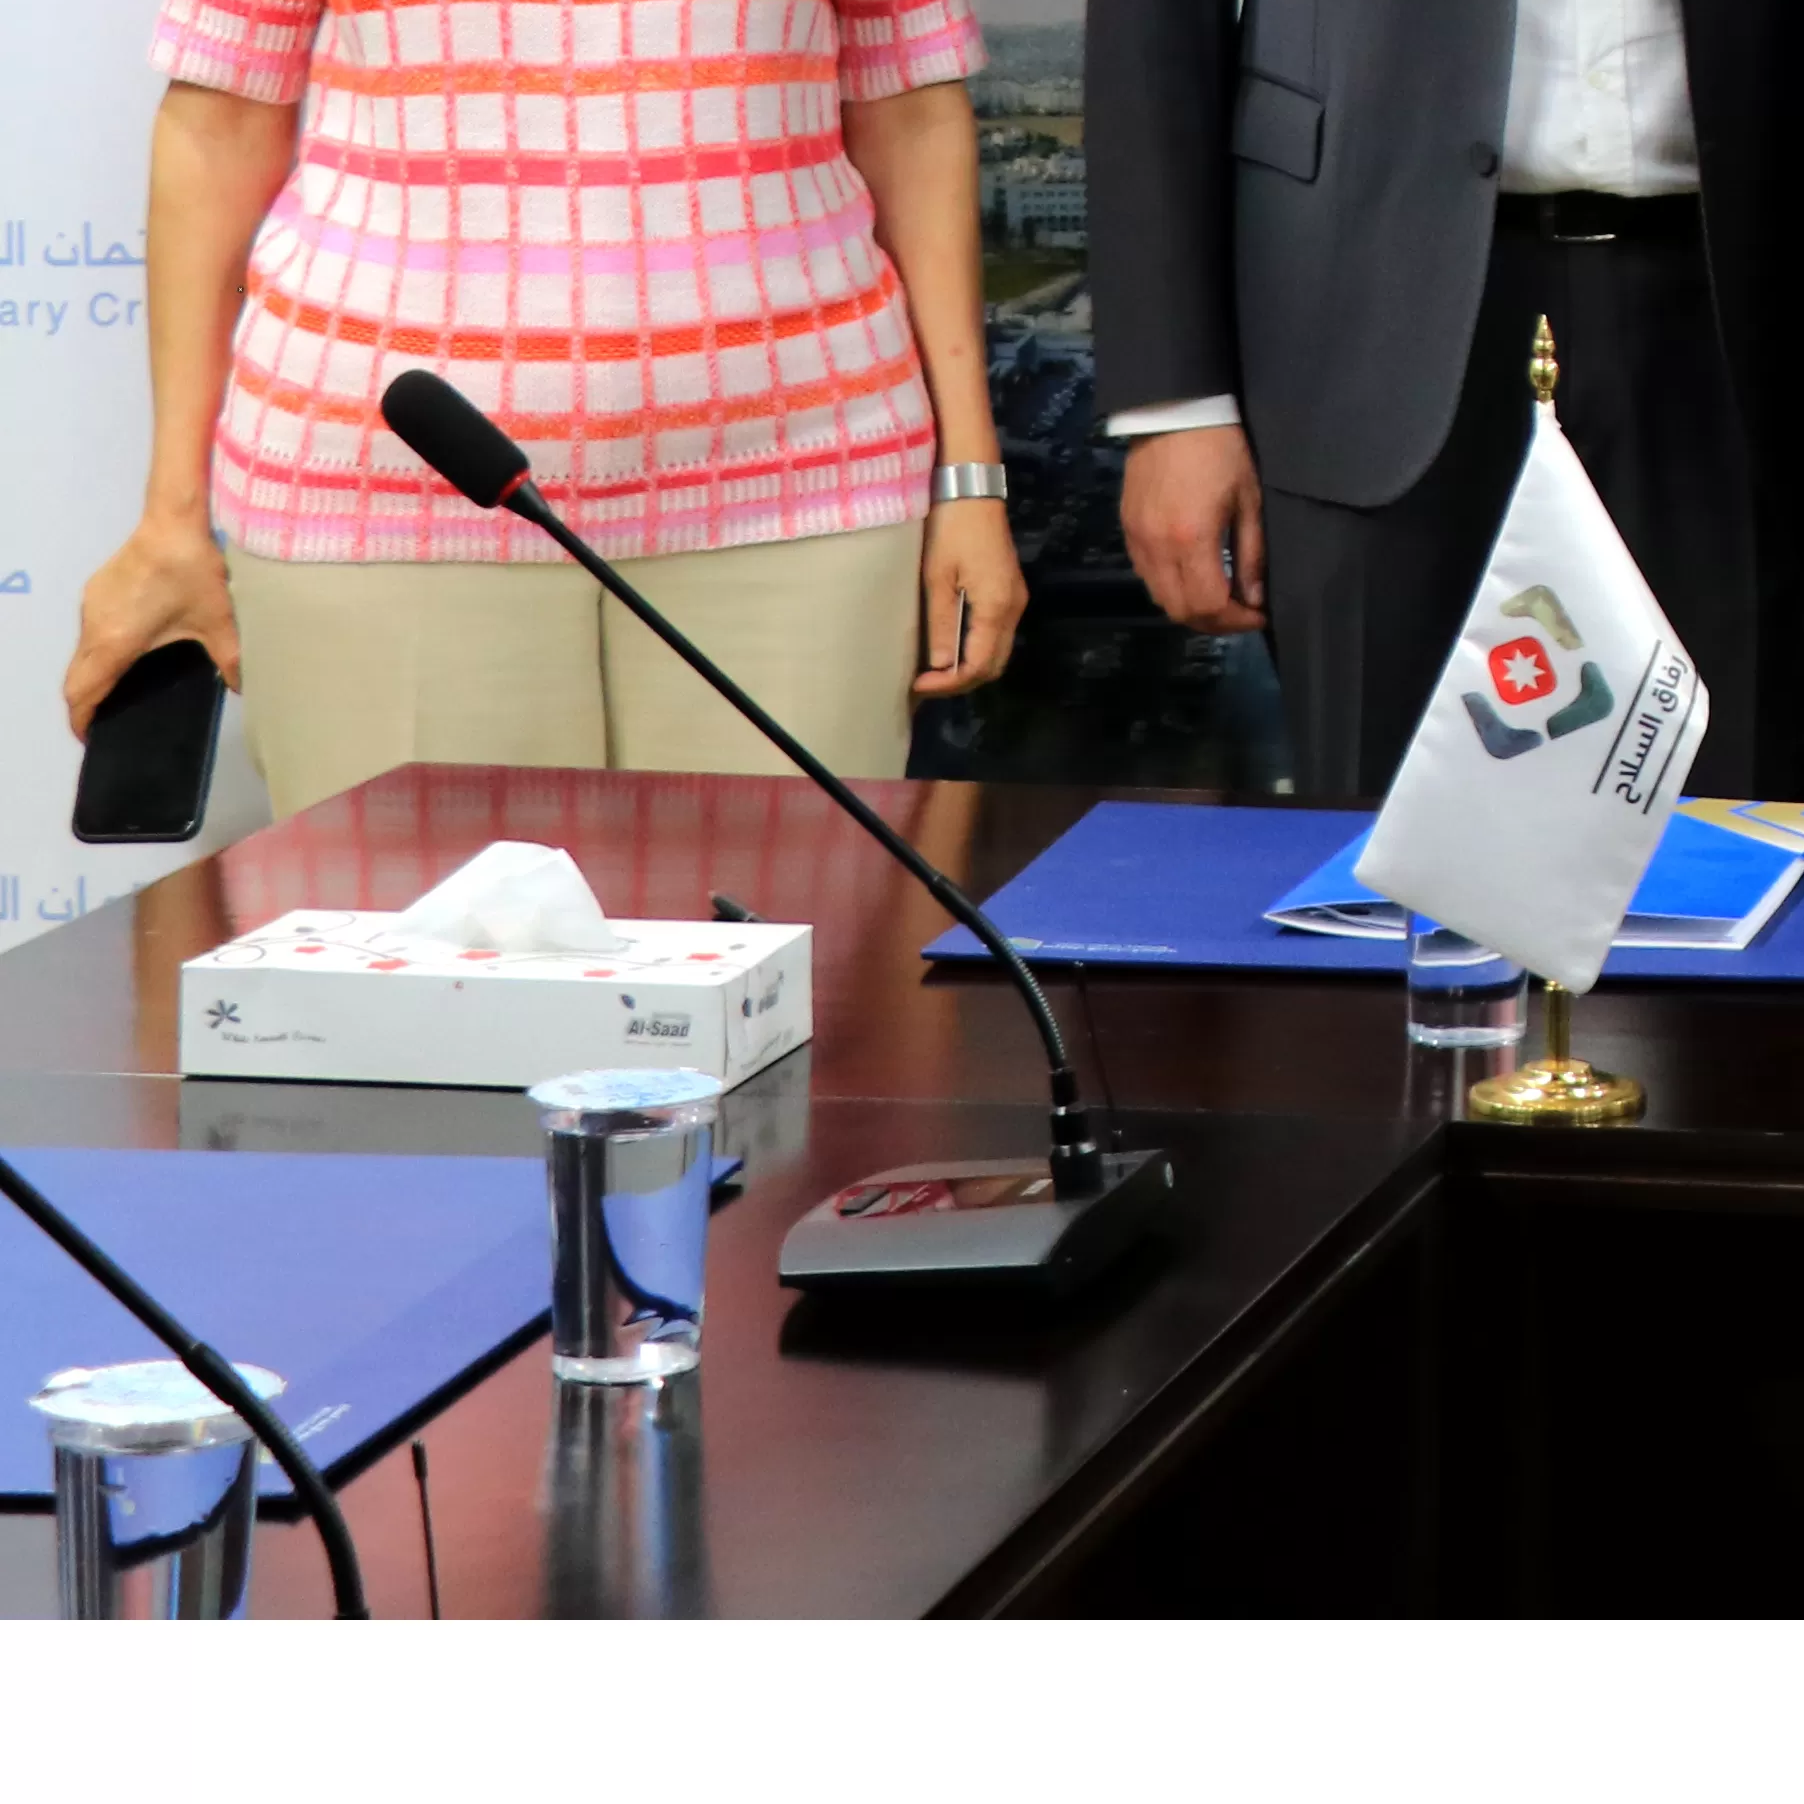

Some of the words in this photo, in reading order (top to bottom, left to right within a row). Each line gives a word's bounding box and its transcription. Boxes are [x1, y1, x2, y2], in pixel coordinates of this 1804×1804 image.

[1653, 655, 1688, 712] رفاق
[1616, 713, 1664, 804] السلاح
[628, 1019, 690, 1038] Al-Saad
